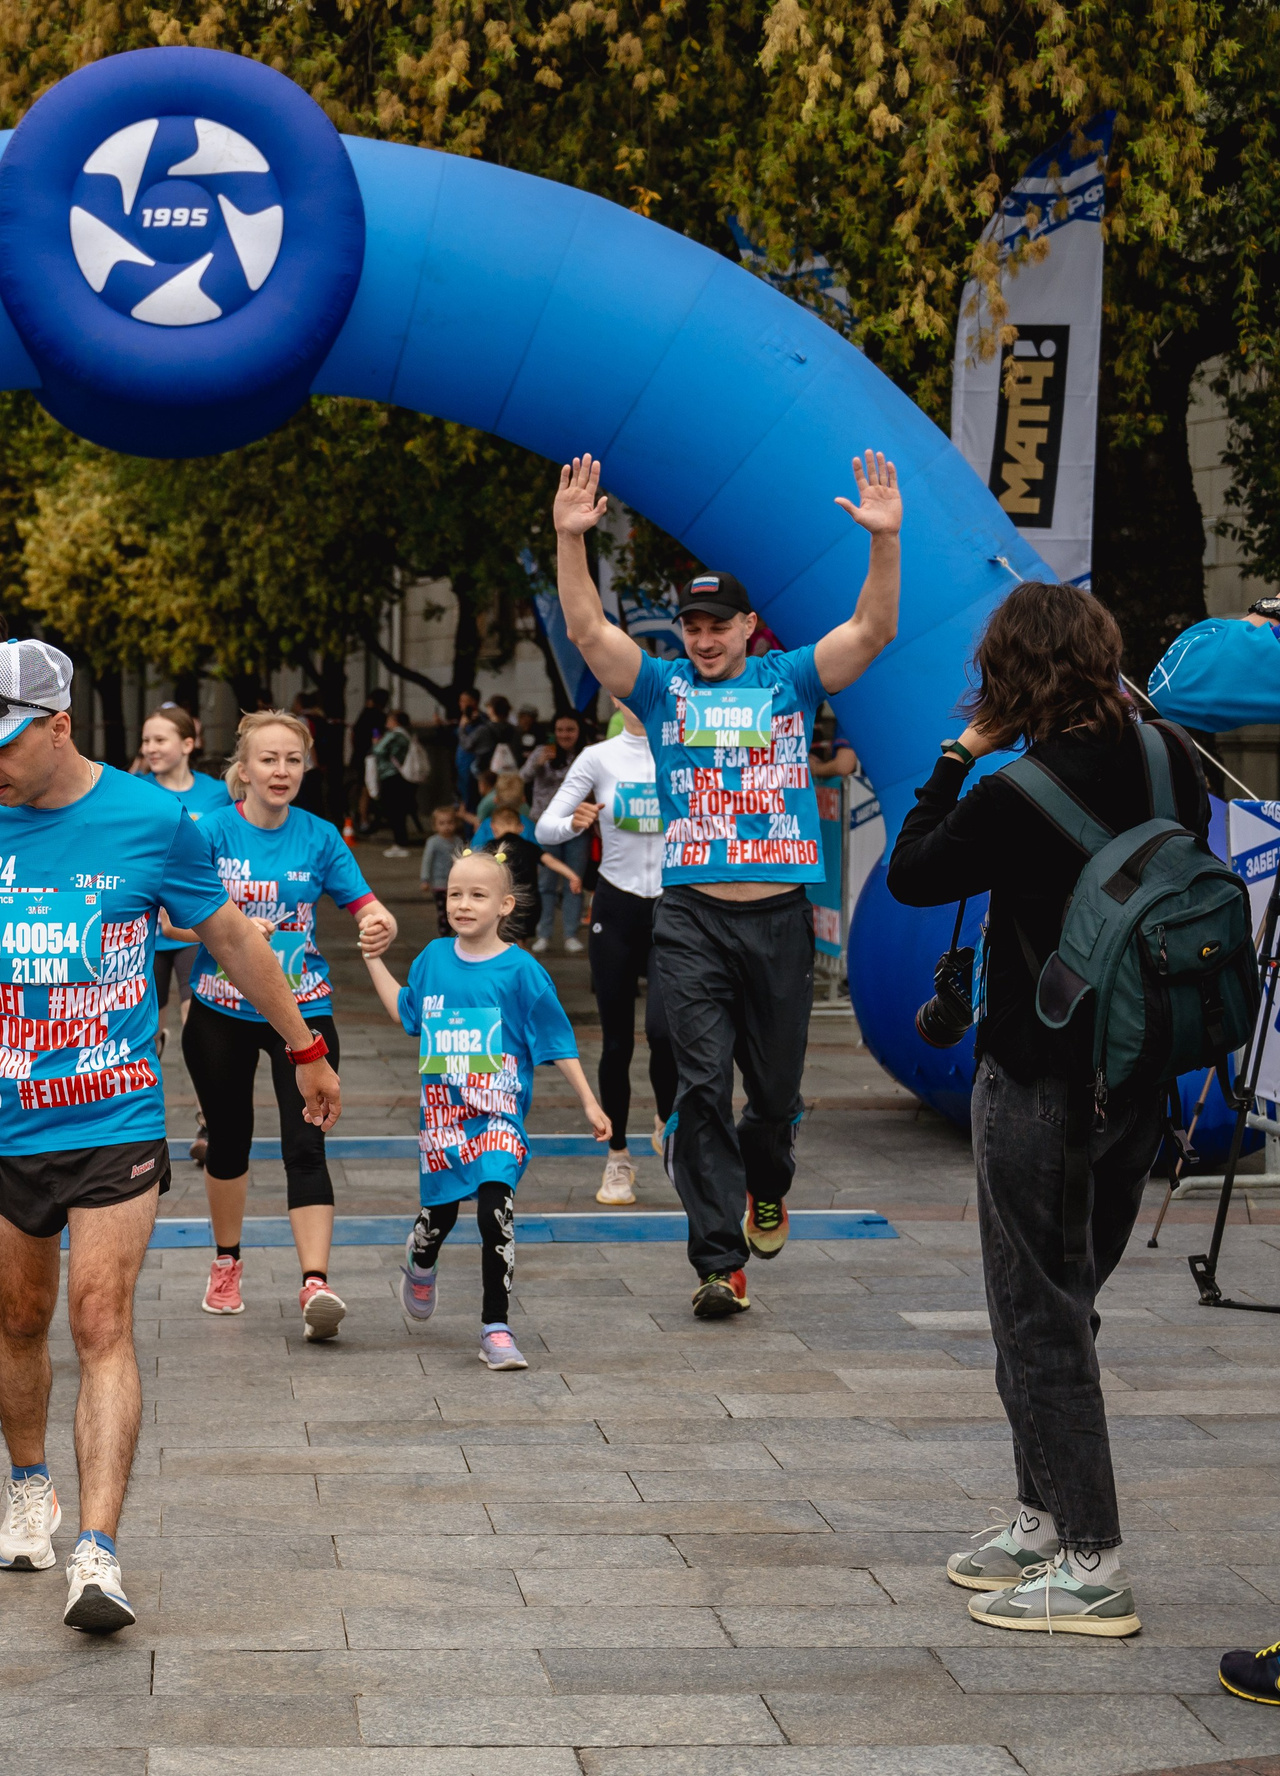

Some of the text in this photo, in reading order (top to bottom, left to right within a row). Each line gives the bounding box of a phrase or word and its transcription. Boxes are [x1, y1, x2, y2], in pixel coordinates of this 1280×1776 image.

[142, 207, 209, 228] 1995
[704, 707, 754, 728] 10198
[629, 797, 662, 817] 1012
[688, 789, 786, 816] #ГОРДОСТЬ
[768, 813, 801, 840] 2024
[726, 839, 819, 865] #ЕДИНСТВО
[217, 856, 252, 881] 2024
[2, 922, 80, 954] 40054
[435, 1029, 482, 1053] 10182
[75, 1037, 132, 1074] 2024
[16, 1057, 159, 1110] #ЕДИНСТВО
